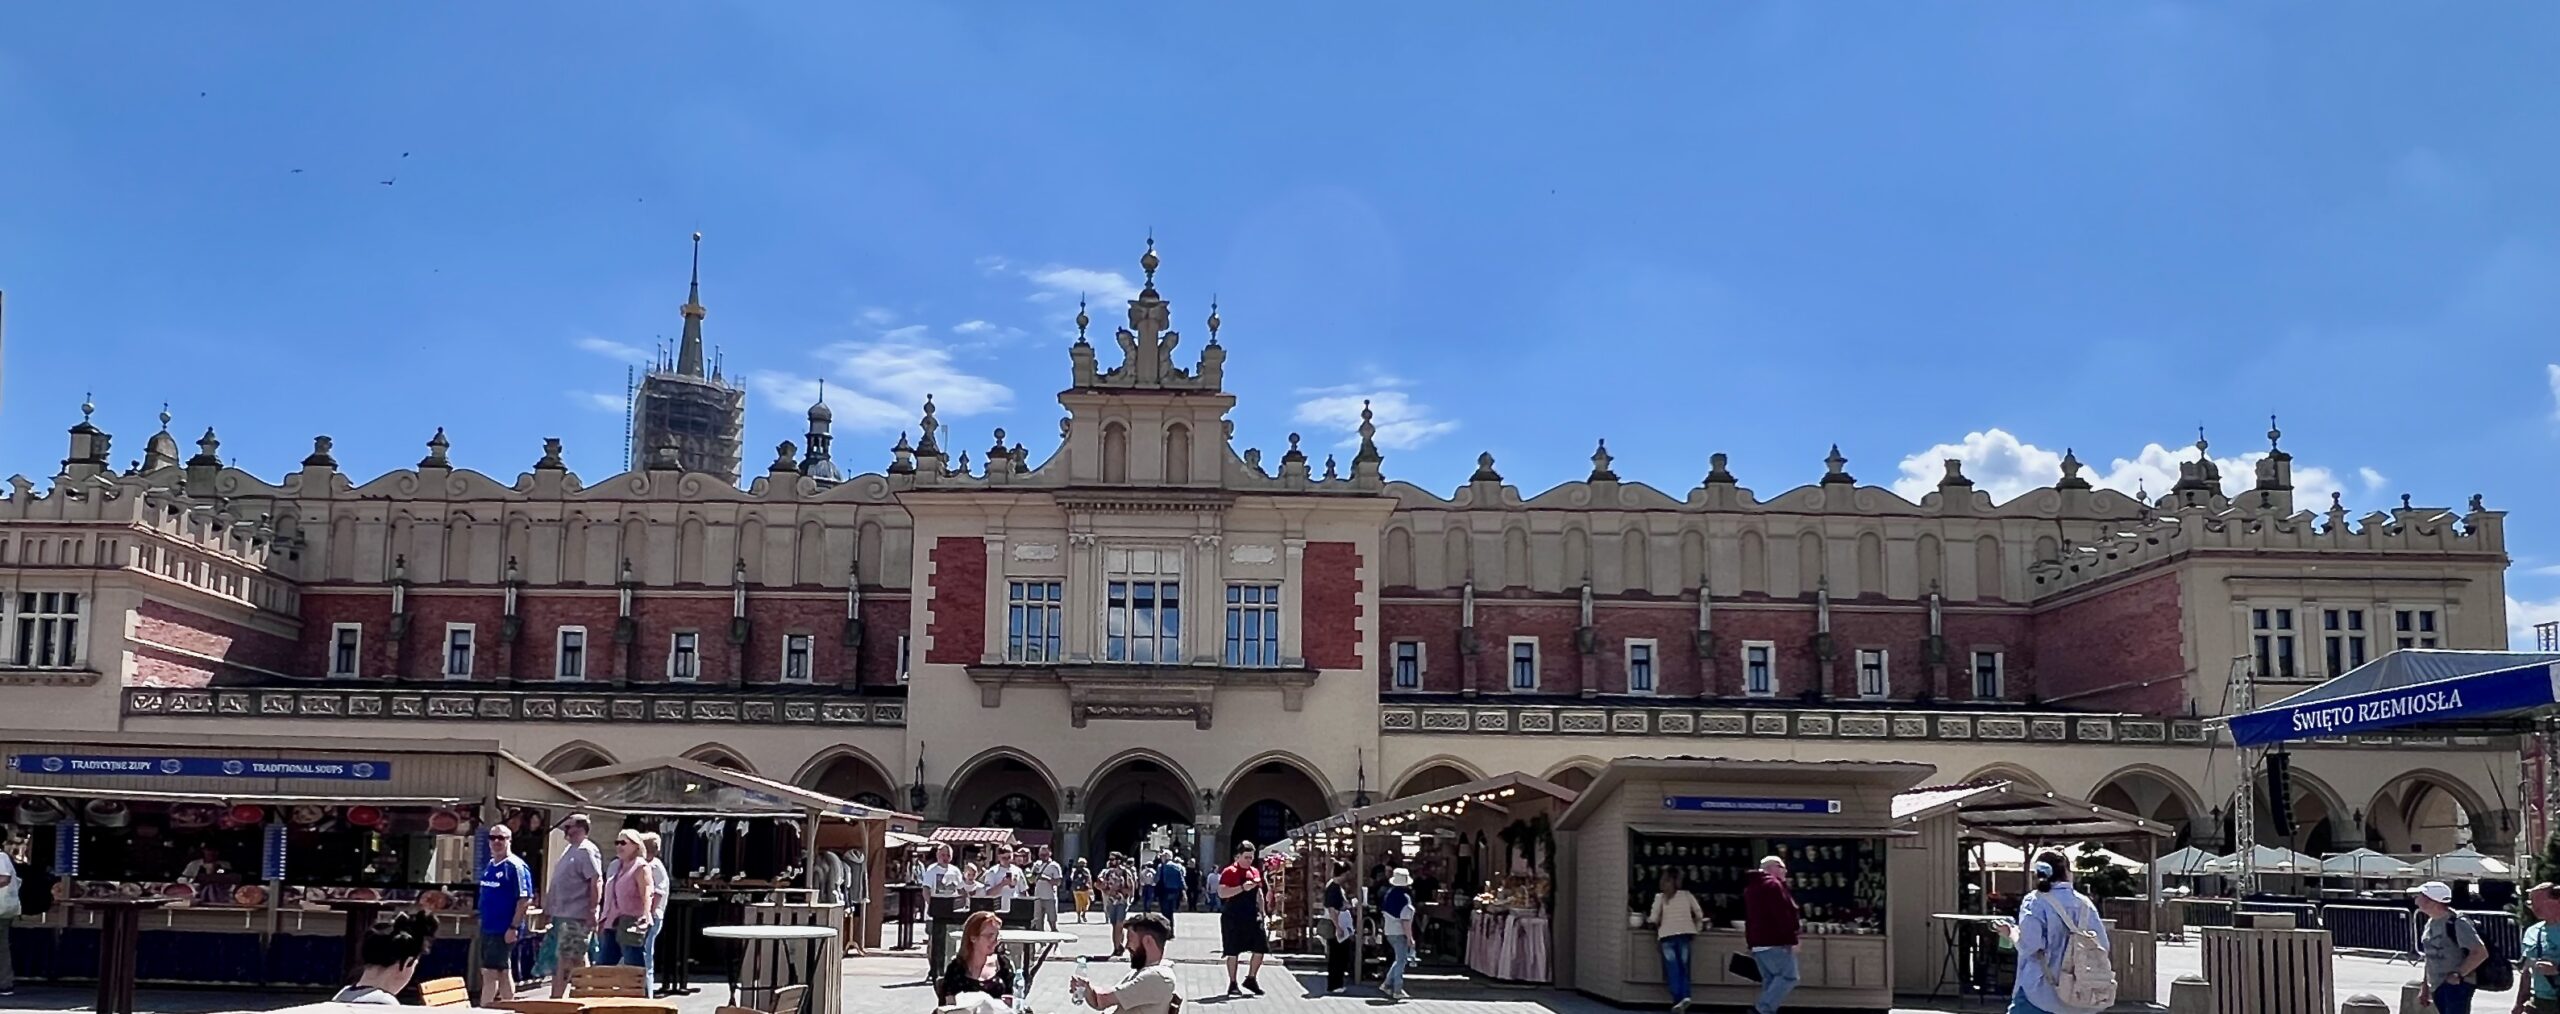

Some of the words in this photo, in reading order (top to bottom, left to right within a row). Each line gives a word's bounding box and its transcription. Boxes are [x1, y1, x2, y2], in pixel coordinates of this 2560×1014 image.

[2292, 705, 2354, 732] ŚWIĘTO
[2358, 689, 2463, 722] RZEMIOSŁA
[71, 759, 127, 771] TRADYCYJNE
[128, 760, 152, 770] ZUPY
[252, 763, 314, 773] TRADITIONAL
[315, 764, 344, 774] SOUPS
